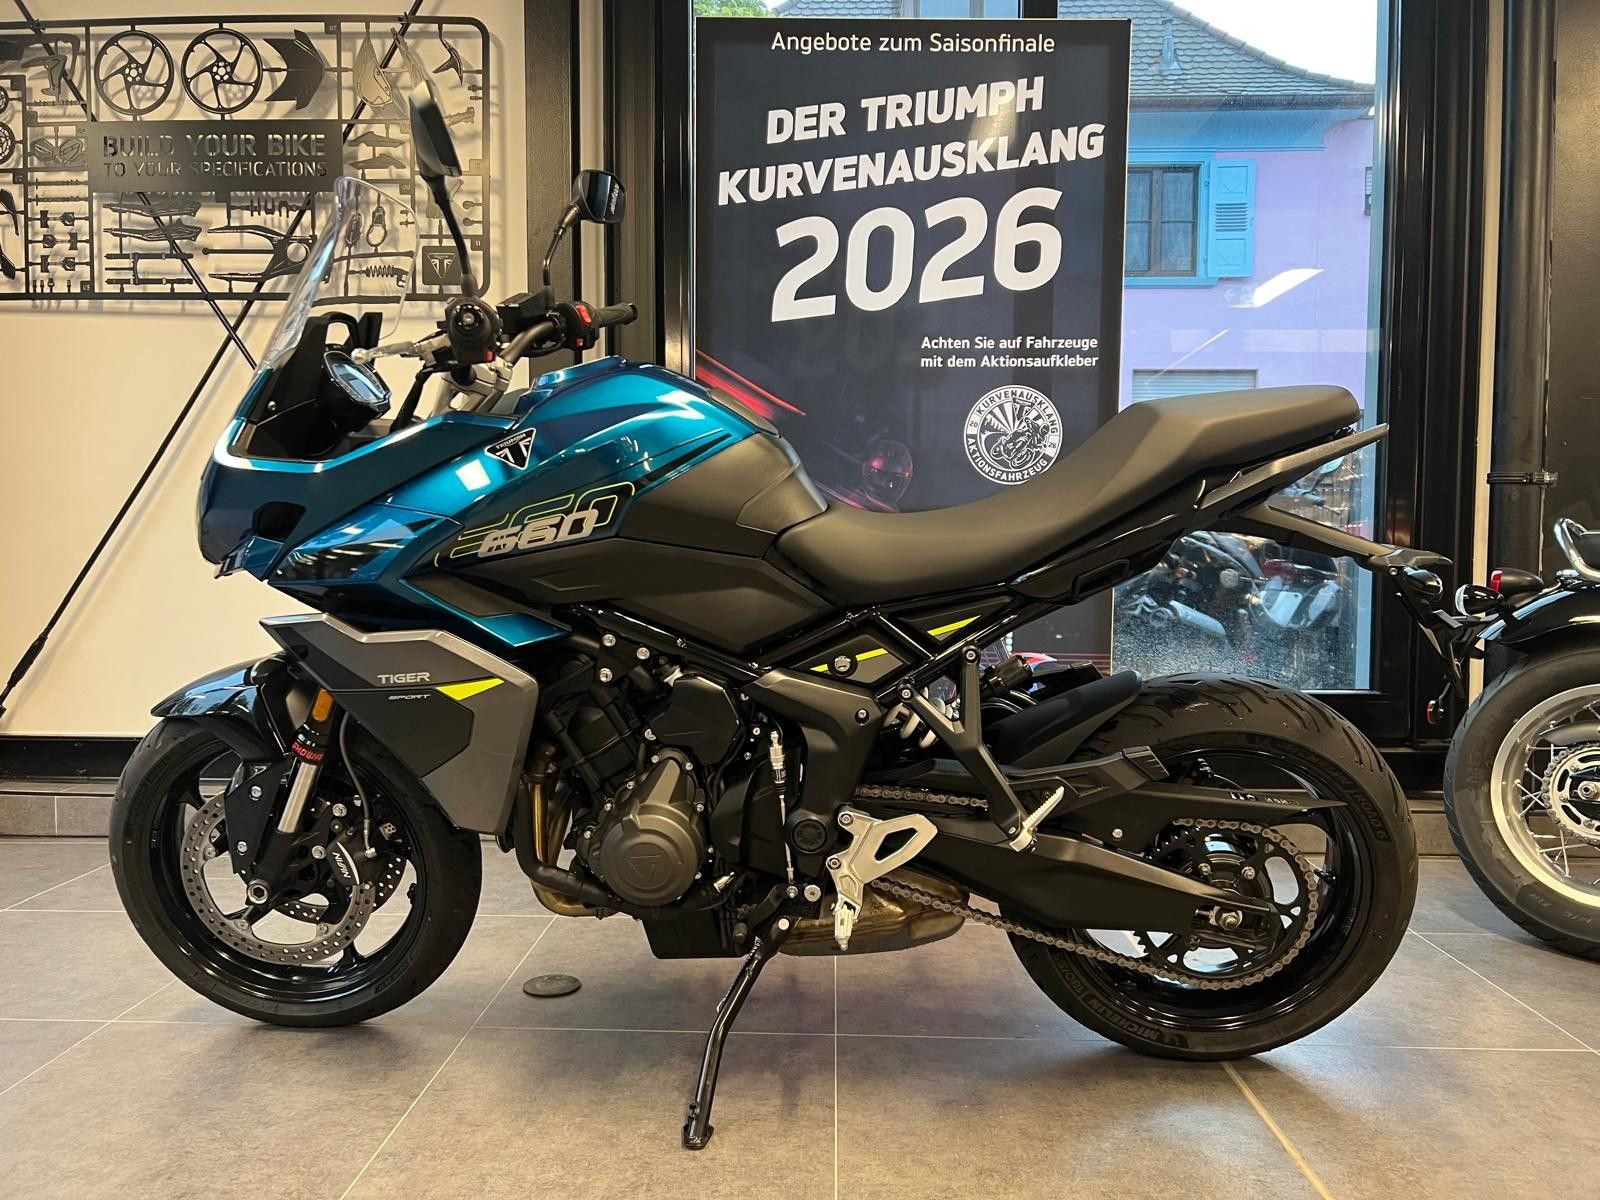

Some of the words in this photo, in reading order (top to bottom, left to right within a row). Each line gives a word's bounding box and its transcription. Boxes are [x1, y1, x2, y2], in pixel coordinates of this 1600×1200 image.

[771, 31, 872, 55] Angebote
[879, 37, 922, 52] zum
[929, 32, 1055, 53] Saisonfinale
[766, 101, 846, 145] DER
[860, 75, 1045, 132] TRIUMPH
[103, 134, 174, 157] BUILD
[186, 134, 257, 156] YOUR
[267, 133, 326, 157] BIKE
[104, 161, 126, 177] TO
[134, 161, 181, 177] YOUR
[190, 161, 327, 177] SPECIFICATIONS
[717, 122, 1107, 206] KURVENAUSKLANG
[770, 186, 1064, 323] 2026
[920, 336, 970, 350] Achten
[974, 336, 995, 349] Sie
[999, 336, 1023, 349] auf
[1026, 336, 1098, 351] Fahrzeuge
[920, 355, 943, 368] mit
[947, 355, 976, 368] dem
[980, 354, 1099, 368] Aktionsaufkleber
[976, 390, 1059, 434] KURVENAUSKLANG
[967, 437, 1049, 481] AKTIONSFAHRZEUG
[477, 508, 599, 558] 660
[376, 671, 431, 684] TIGER
[332, 852, 351, 878] NISSIN
